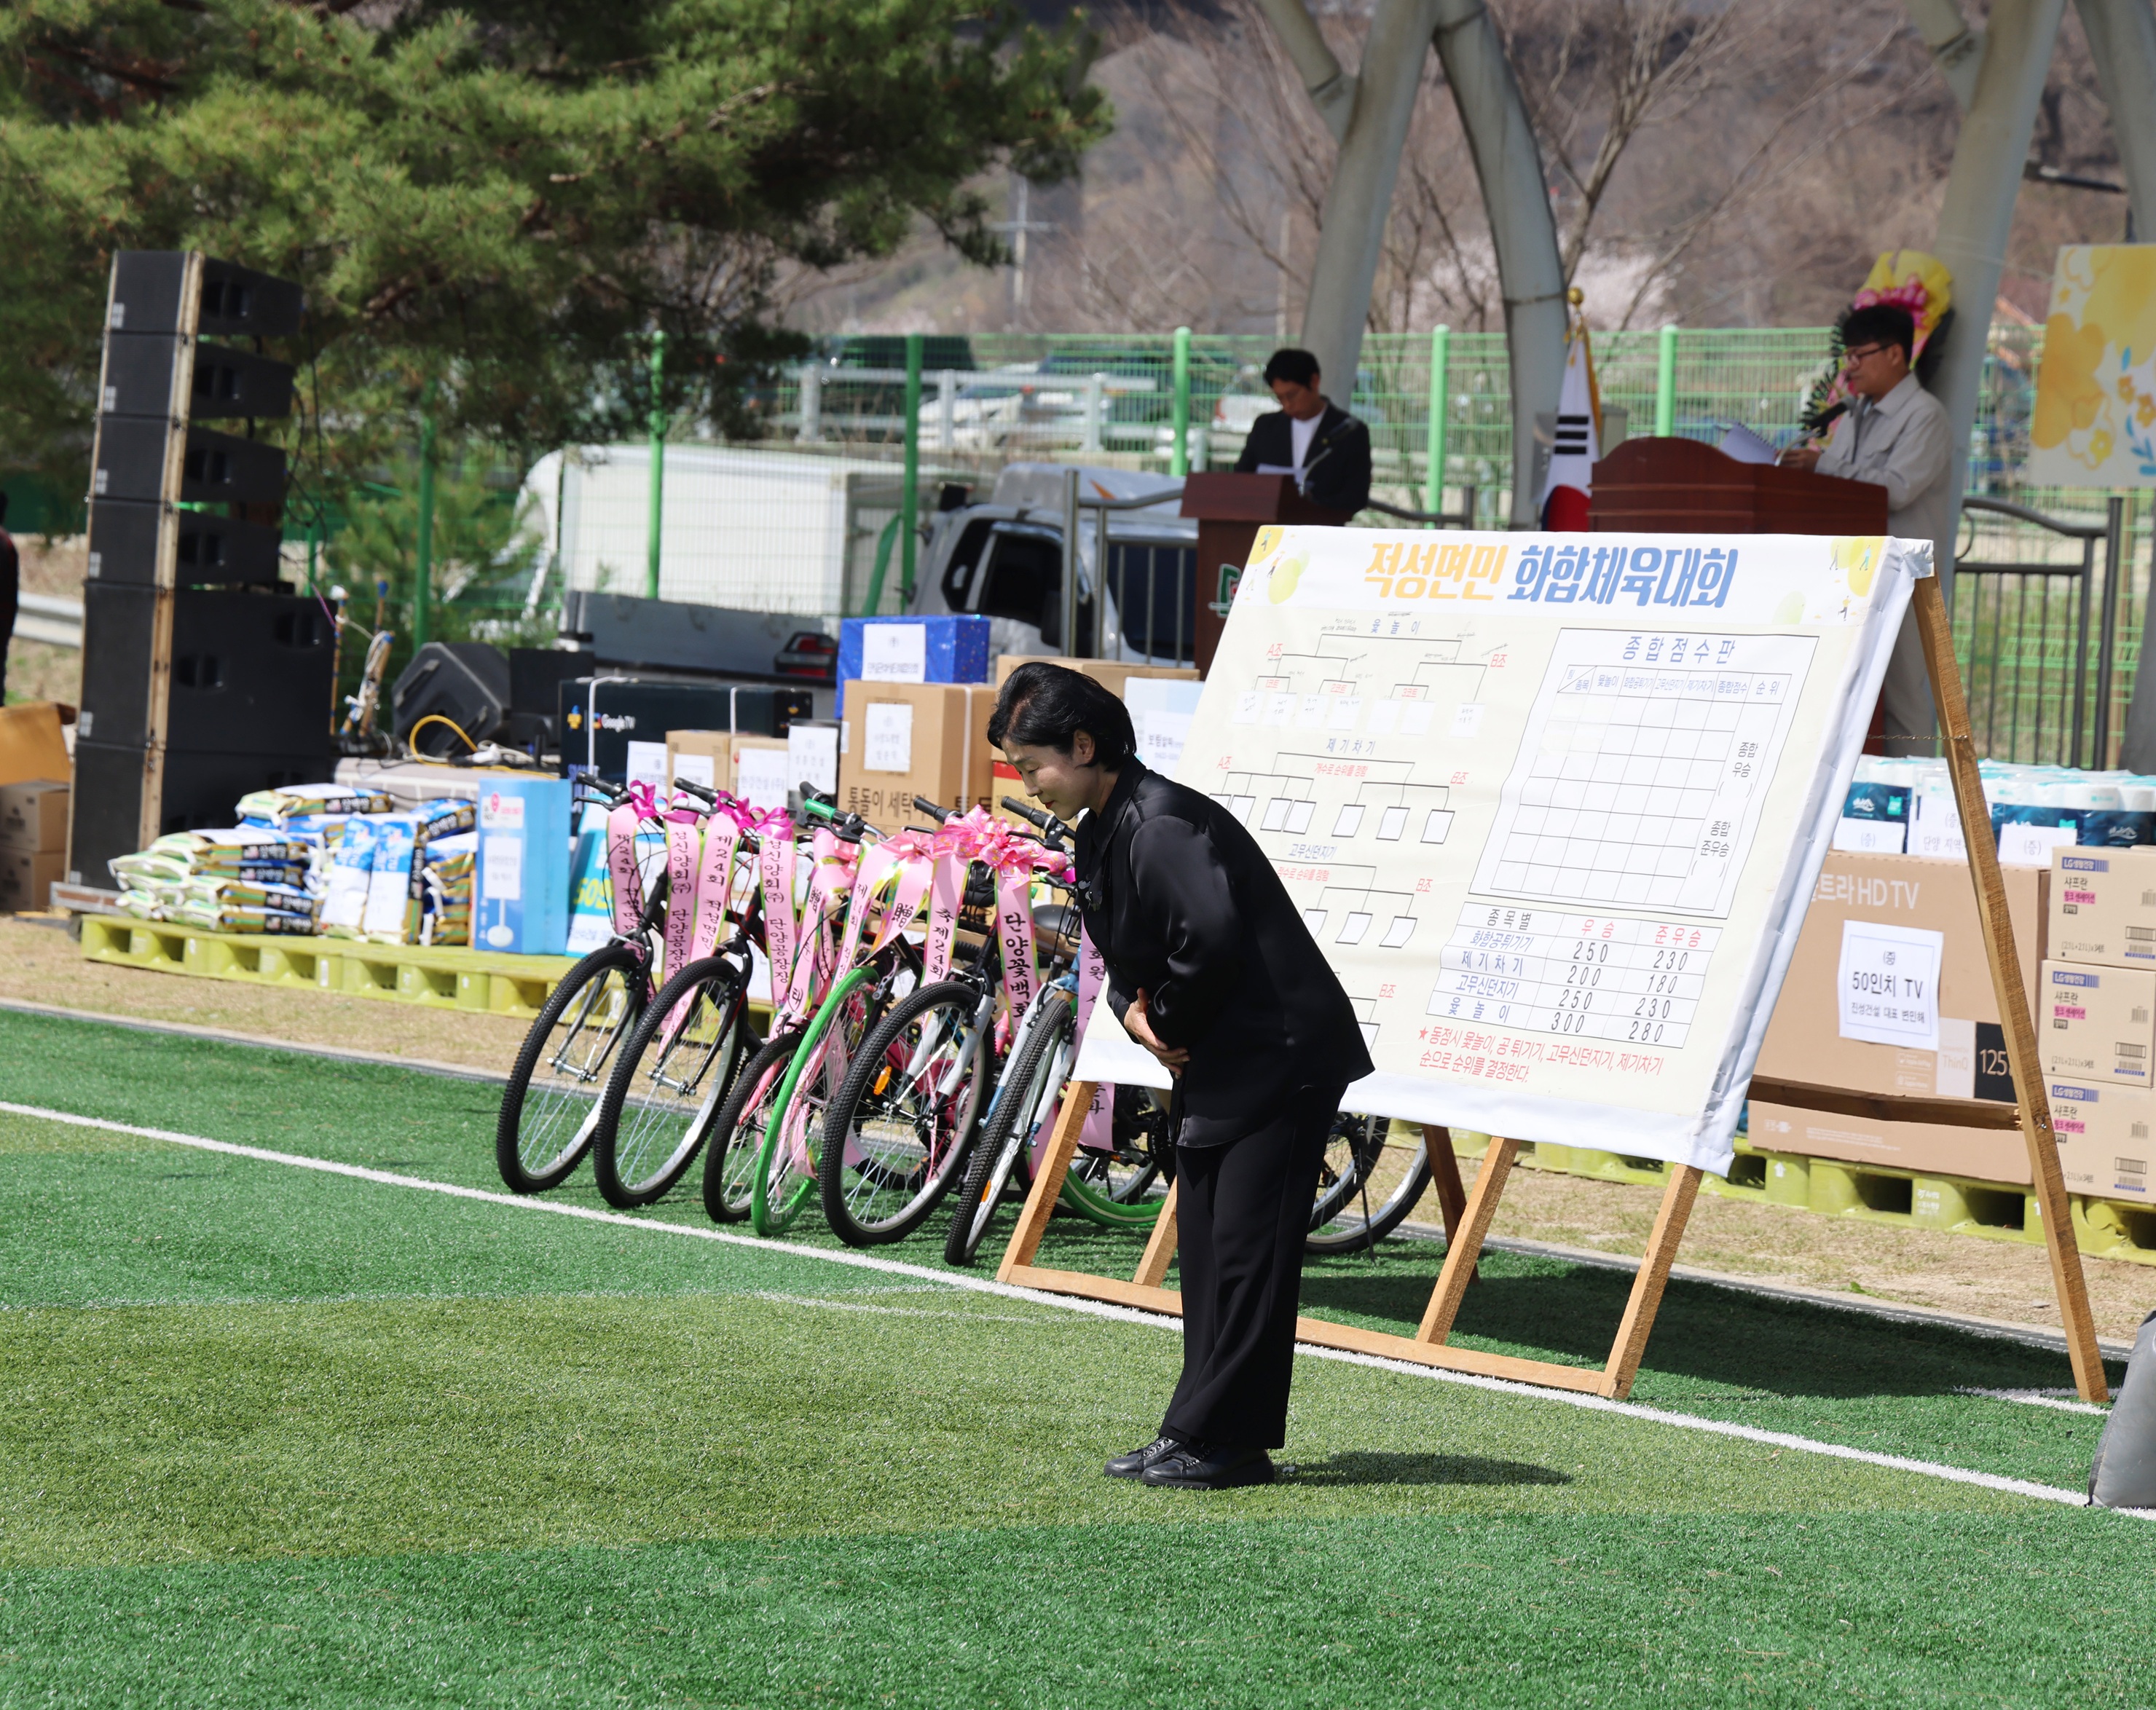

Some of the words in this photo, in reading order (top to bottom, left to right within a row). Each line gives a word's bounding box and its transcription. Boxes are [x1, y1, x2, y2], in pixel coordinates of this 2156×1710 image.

[1364, 542, 1508, 601] 적성면민
[1507, 545, 1739, 608] 화합체육대회
[1266, 643, 1283, 657] A조
[1490, 654, 1508, 668] B조
[1687, 679, 1715, 693] 제기차기
[1718, 681, 1748, 694] 종합점수
[1738, 741, 1758, 758] 종합
[1216, 756, 1232, 769] A조
[1334, 764, 1355, 776] 순위를
[1732, 762, 1751, 778] 우승
[1450, 771, 1468, 785] B조
[1710, 821, 1731, 837] 종합
[1289, 843, 1337, 859] 고무신던지기
[1700, 840, 1729, 857] 준우승
[1944, 838, 1967, 853] 지역
[707, 835, 733, 886] 제24회
[1415, 878, 1433, 892] B조
[1890, 880, 1920, 909] TV
[1487, 908, 1532, 931] 종목별
[1655, 926, 1701, 948] 준우승
[929, 926, 949, 980] 제24회
[1470, 929, 1534, 951] 화합공튀기기
[1573, 941, 1608, 963] 250
[1653, 950, 1688, 971] 230
[1461, 950, 1524, 974] 제기차기
[1567, 965, 1602, 987] 200
[1646, 974, 1677, 995] 180
[1378, 984, 1396, 998] B조
[1852, 971, 1897, 998] 50인치
[1905, 978, 1924, 998] TV
[1455, 974, 1519, 999] 고무신던지기
[1558, 989, 1593, 1011] 250
[1634, 997, 1671, 1019] 230
[1550, 1012, 1585, 1034] 300
[1628, 1021, 1664, 1043] 280
[1429, 1025, 1463, 1047] 동점시
[1546, 1044, 1615, 1071] 고무신던지기,
[1616, 1053, 1664, 1076] 제기차기
[1419, 1049, 1452, 1069] 순으로
[1452, 1054, 1485, 1076] 순위를
[1484, 1060, 1529, 1083] 결정한다.
[1979, 1049, 2013, 1078] 125
